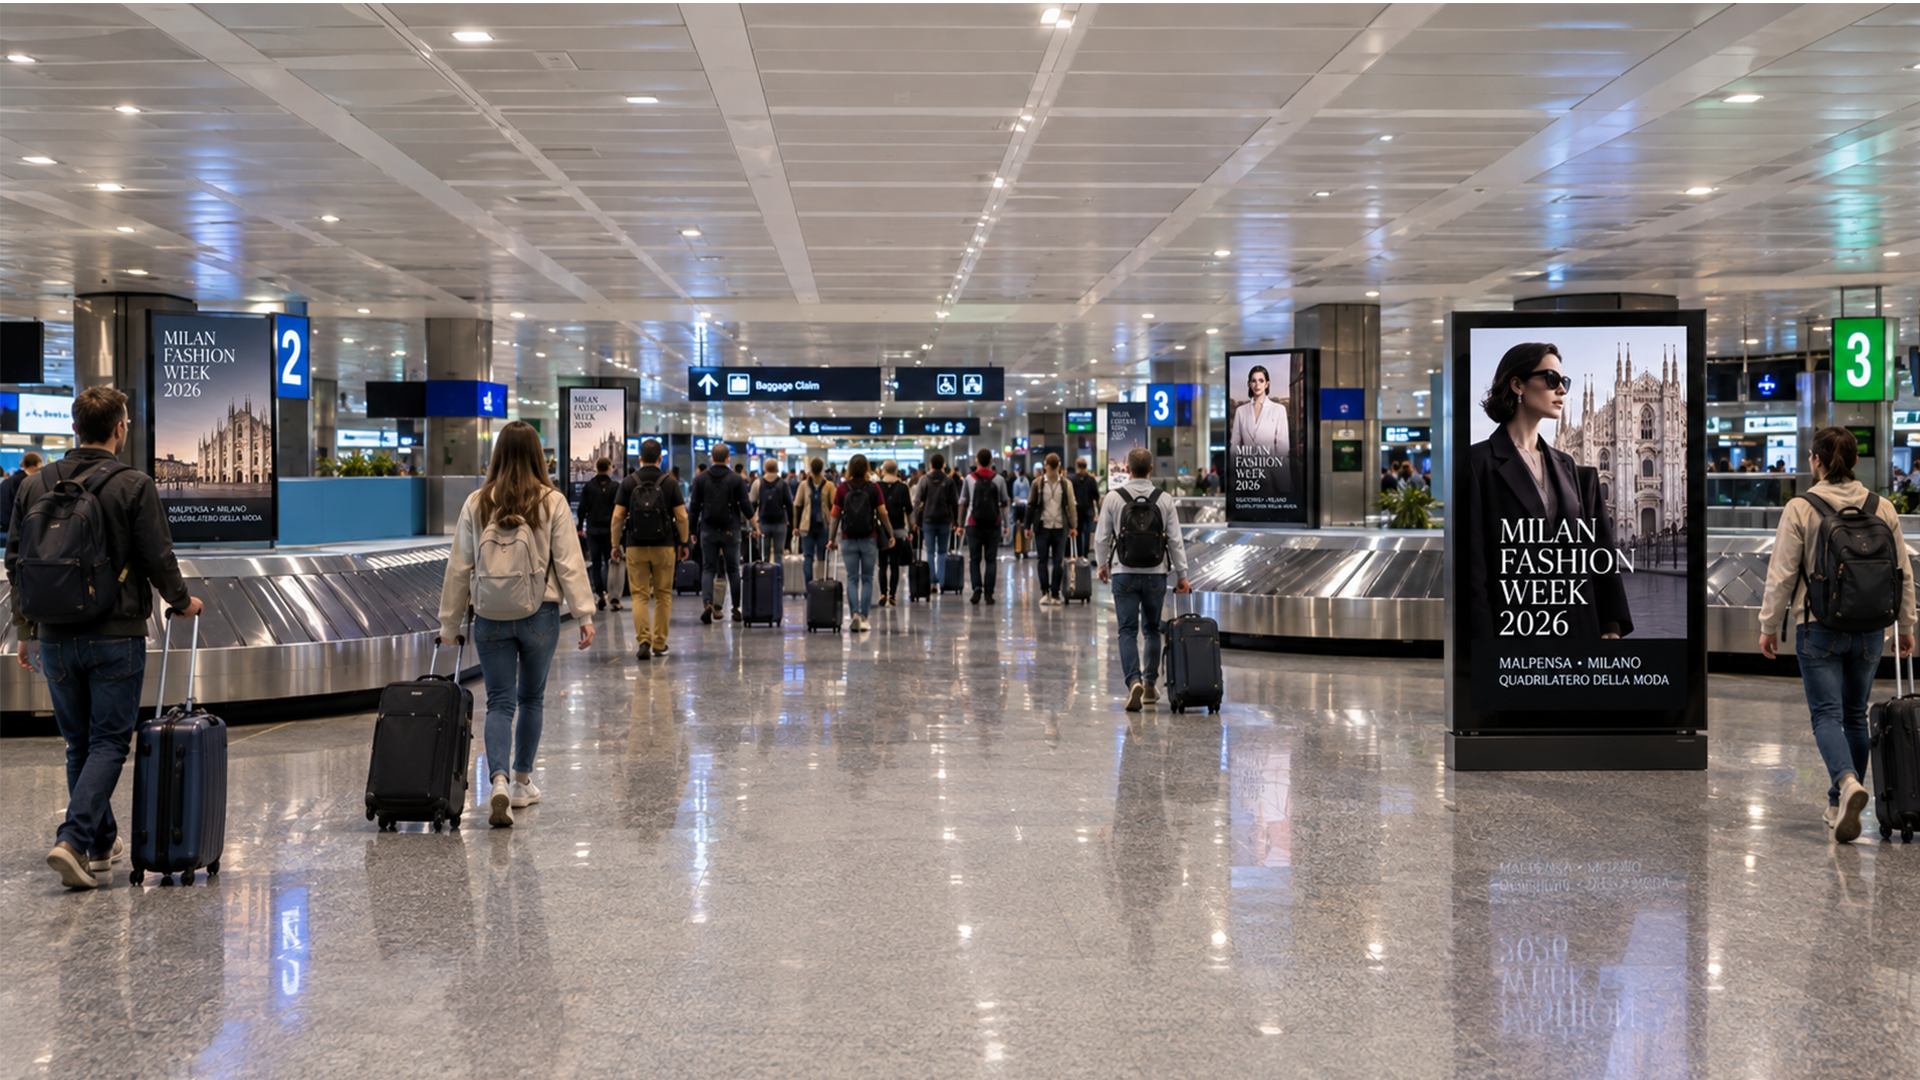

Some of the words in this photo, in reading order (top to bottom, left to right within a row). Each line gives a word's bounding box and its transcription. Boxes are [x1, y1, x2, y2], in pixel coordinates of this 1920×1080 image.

[164, 330, 216, 346] MILAN
[164, 347, 236, 363] FASHION
[281, 329, 302, 386] 2
[1846, 332, 1872, 388] 3
[163, 365, 211, 380] WEEK
[163, 382, 201, 398] 2026
[755, 380, 793, 392] Baggage
[795, 380, 820, 391] Claim
[1153, 391, 1170, 421] 3
[1235, 444, 1272, 456] MILAN
[1235, 456, 1284, 468] FASHION
[1235, 468, 1267, 479] WEEK
[1235, 480, 1261, 491] 2026
[1500, 517, 1597, 544] MILAN
[1500, 547, 1636, 575] FASHION
[1499, 579, 1589, 605] WEEK
[1499, 610, 1569, 637] 2026
[1499, 656, 1573, 669] MALPENSA
[1587, 656, 1642, 669] MILANO
[1499, 674, 1590, 688] QUADRILATERO
[1593, 674, 1631, 686] DELLA
[1633, 674, 1670, 686] MODA
